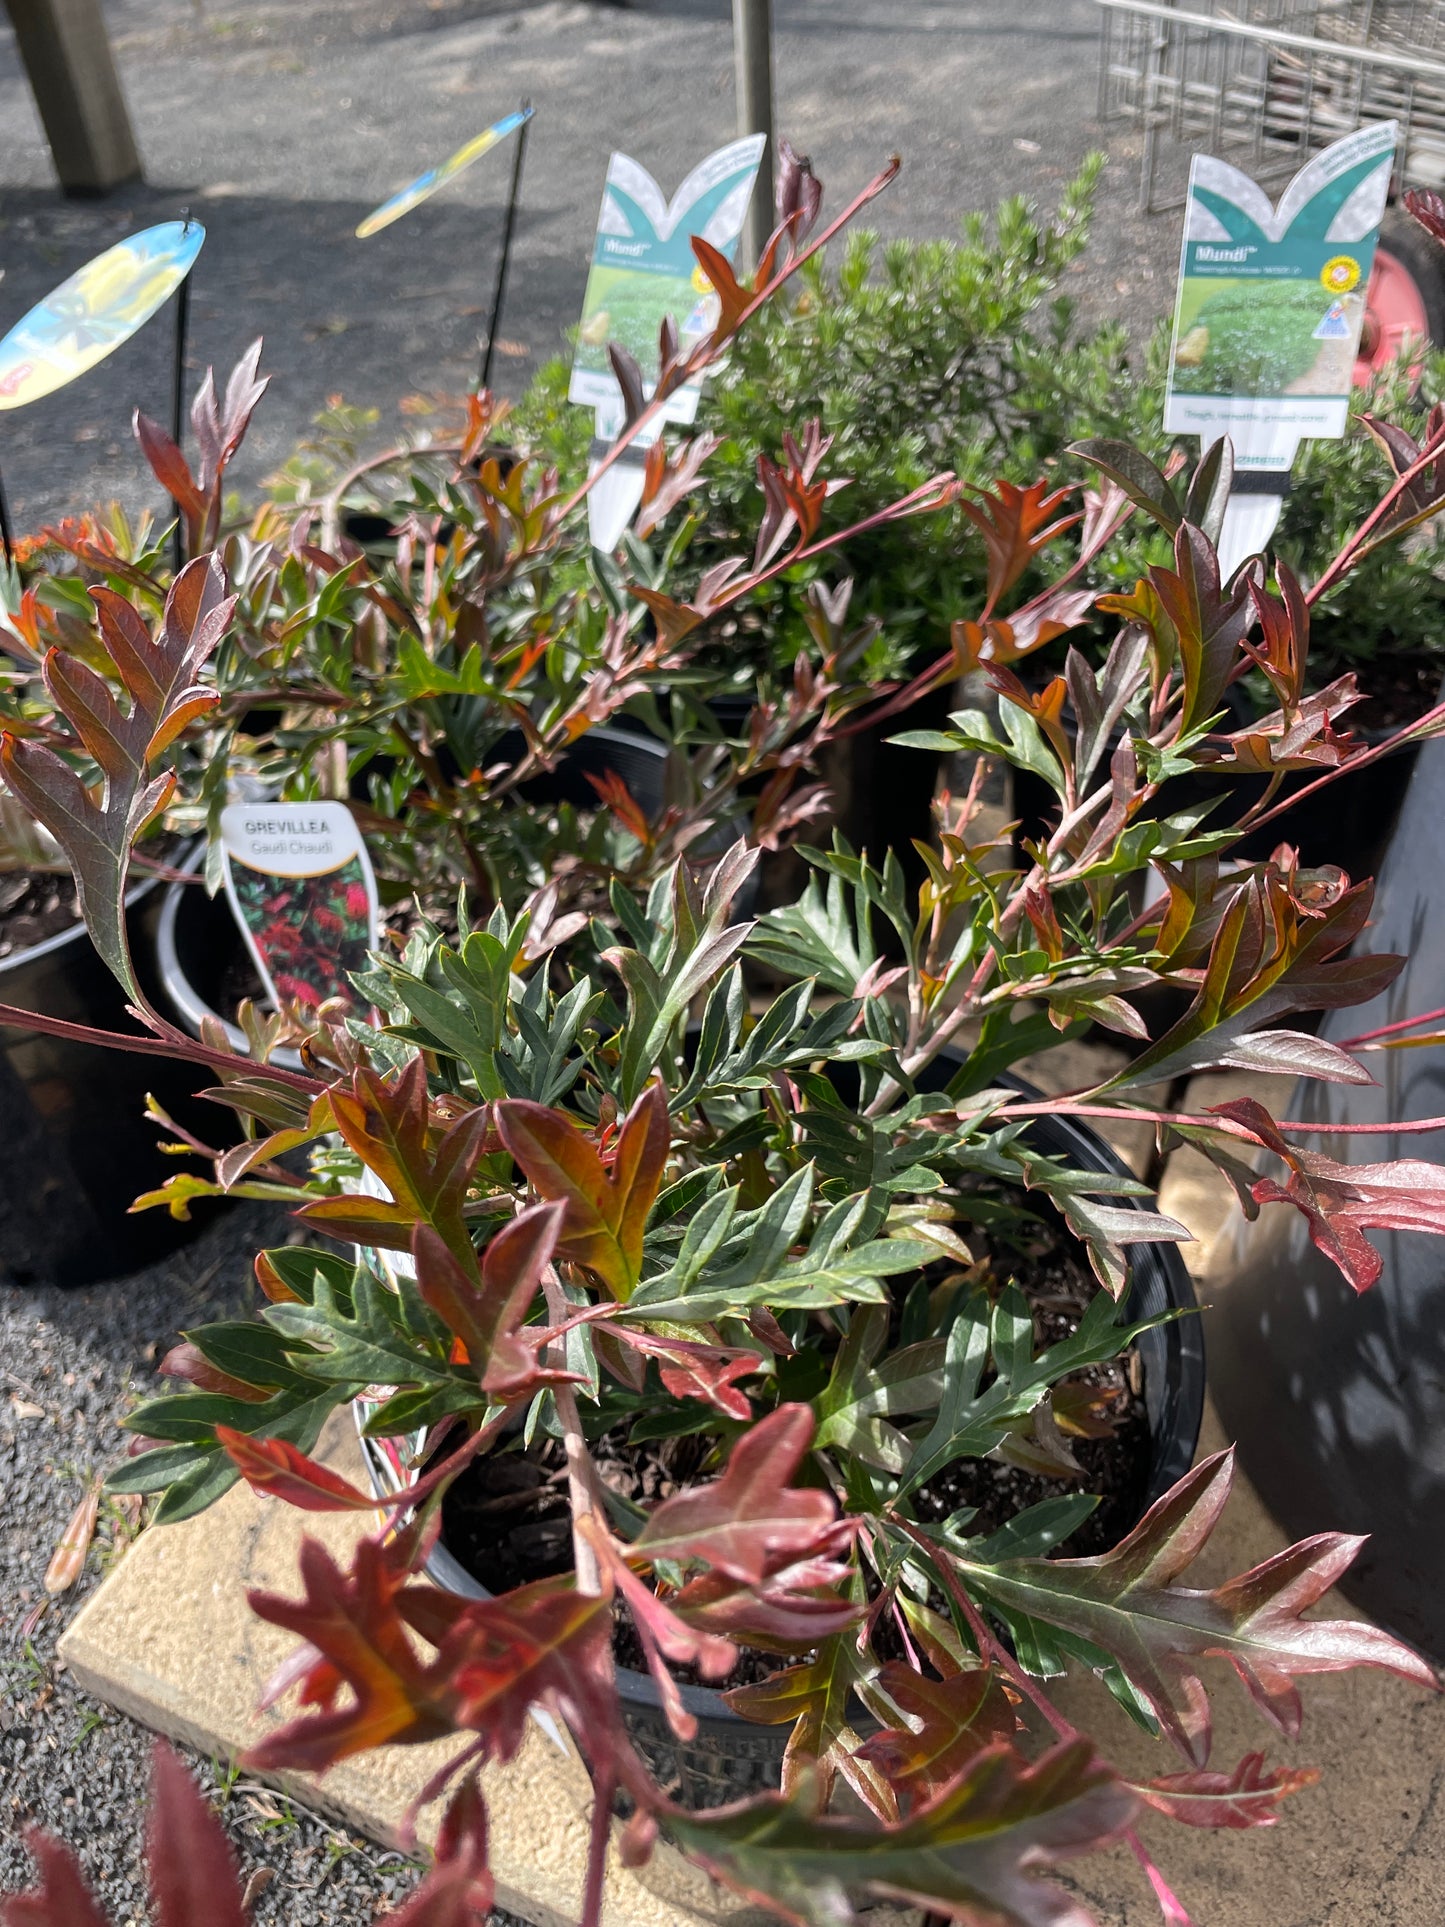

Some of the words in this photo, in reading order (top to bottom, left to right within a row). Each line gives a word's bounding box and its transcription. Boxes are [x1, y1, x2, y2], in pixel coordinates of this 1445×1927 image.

[245, 821, 330, 835] GREVILLEA
[251, 841, 287, 855] Gaudi
[289, 841, 333, 855] Chaudi
